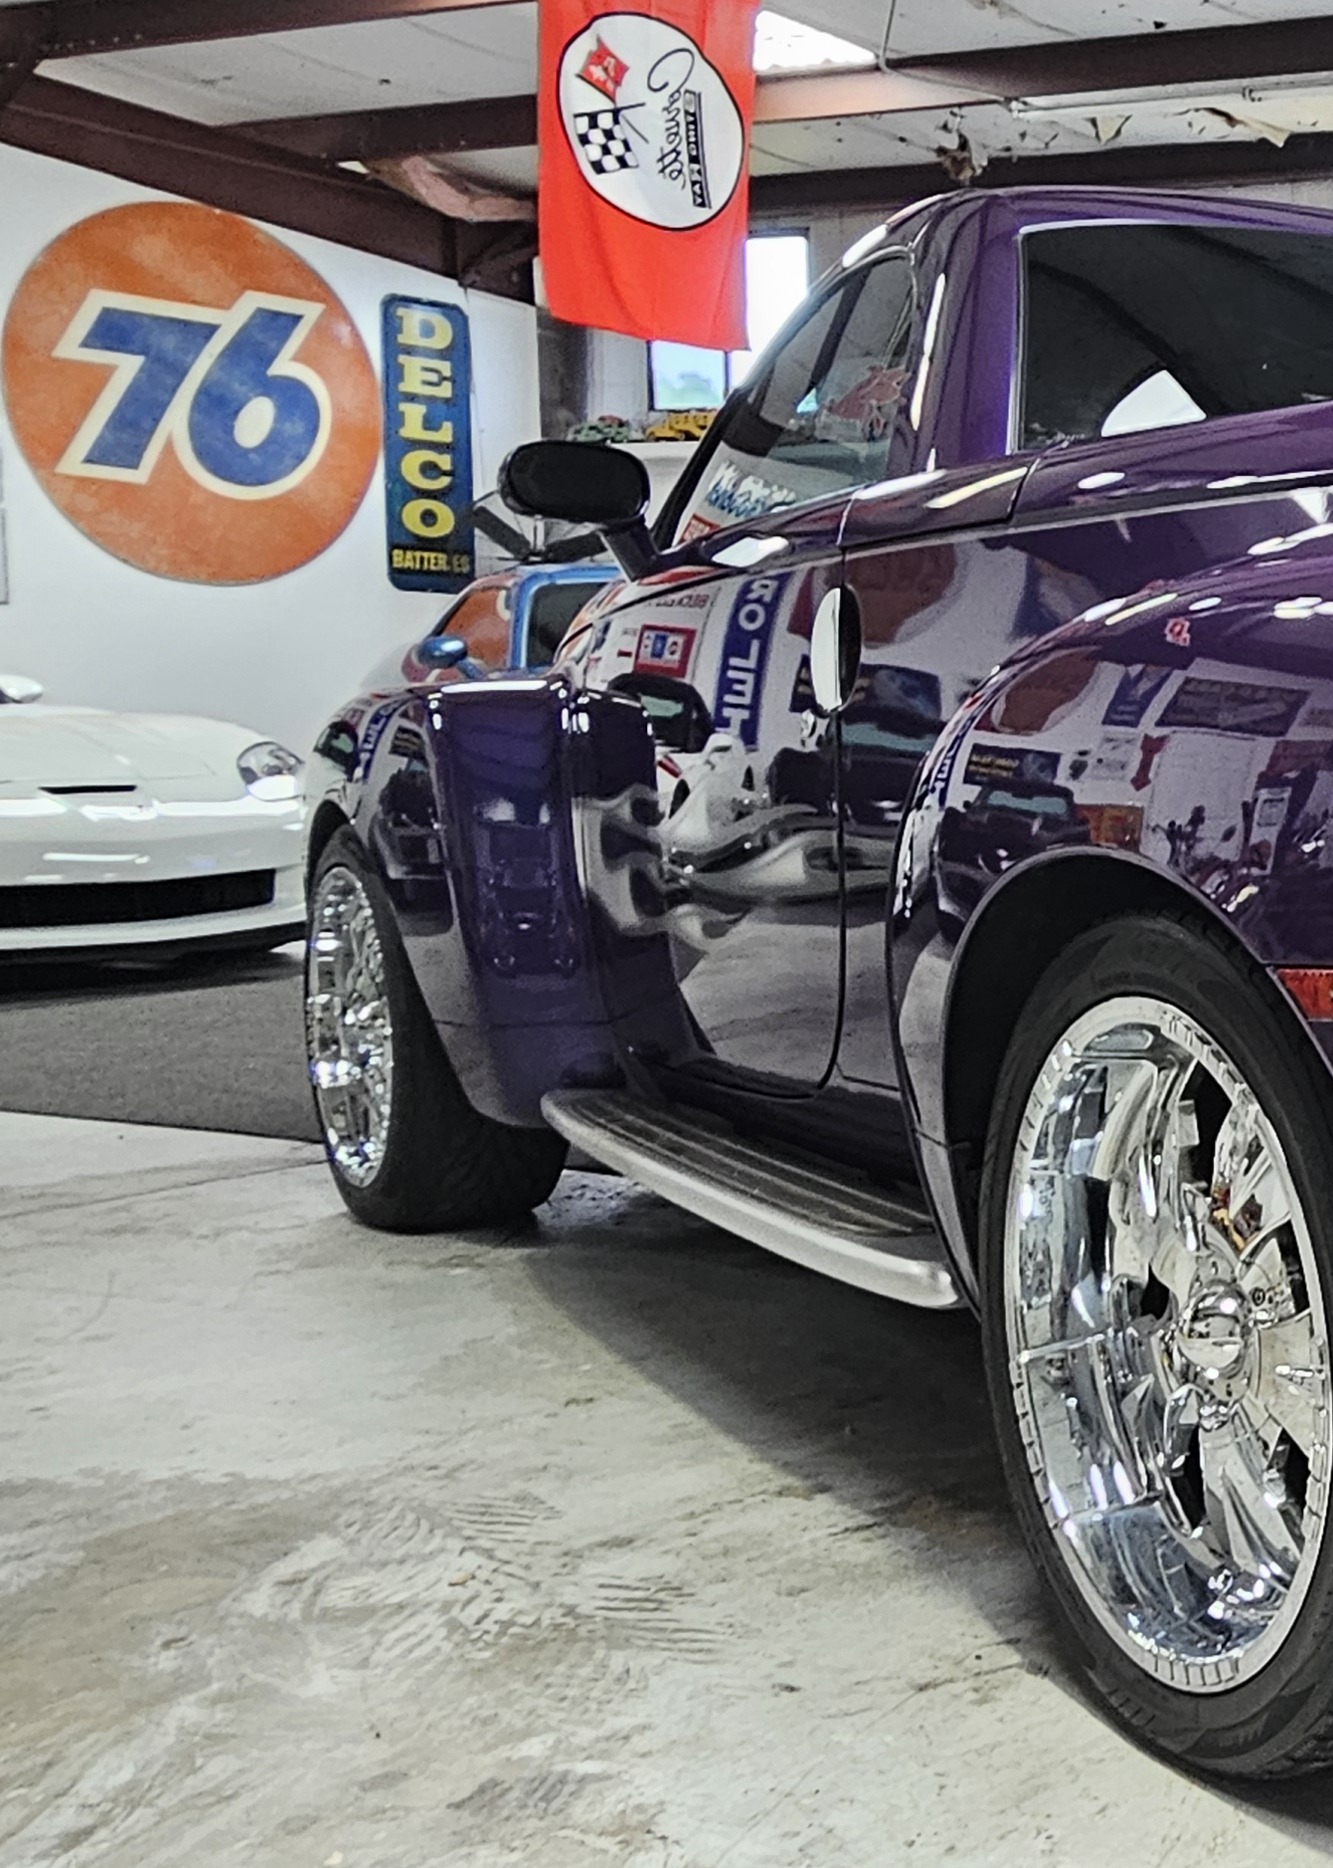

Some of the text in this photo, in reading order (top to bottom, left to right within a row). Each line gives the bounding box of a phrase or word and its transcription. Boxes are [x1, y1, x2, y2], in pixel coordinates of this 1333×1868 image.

[51, 288, 331, 500] 76
[396, 306, 455, 539] DELCO
[391, 548, 471, 575] BATTERES
